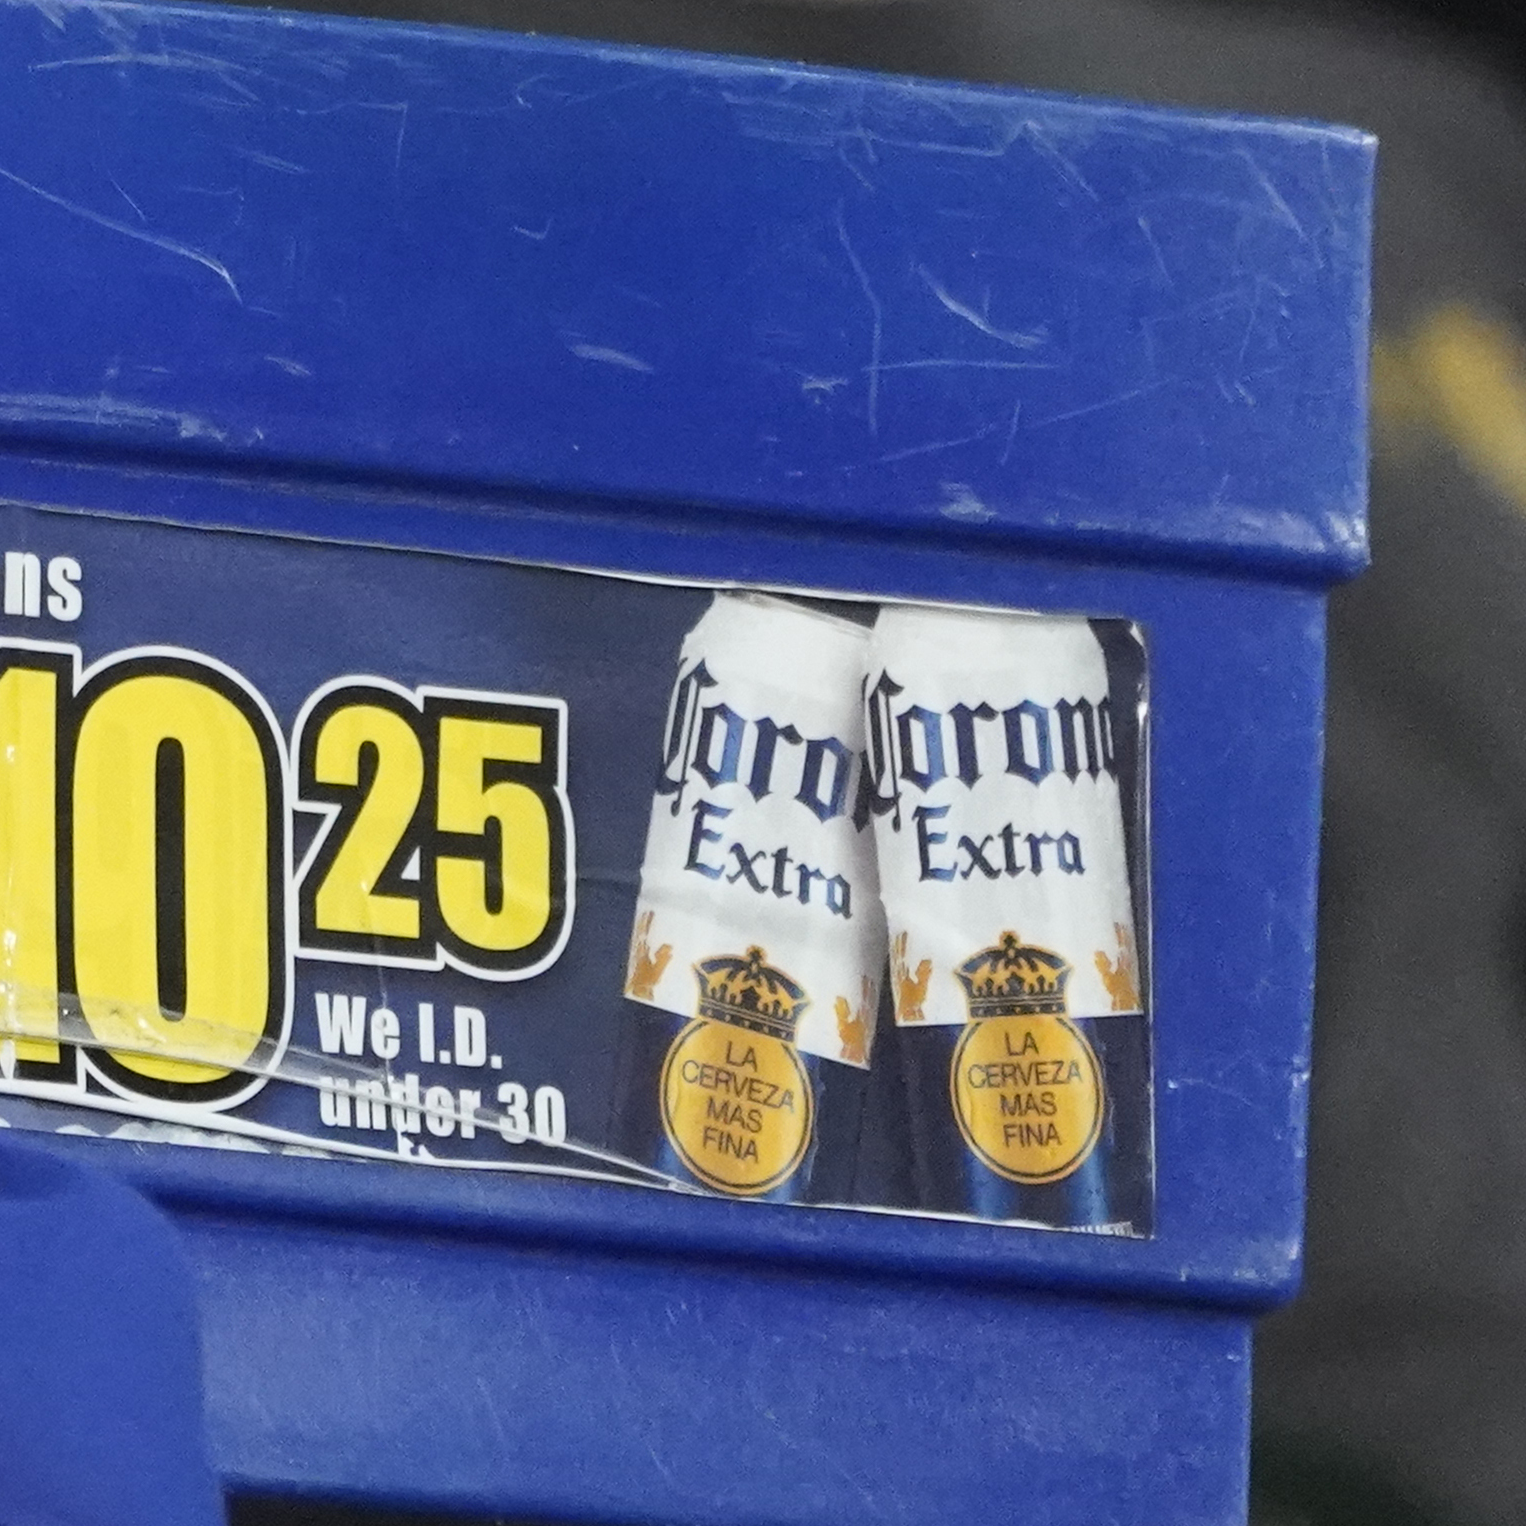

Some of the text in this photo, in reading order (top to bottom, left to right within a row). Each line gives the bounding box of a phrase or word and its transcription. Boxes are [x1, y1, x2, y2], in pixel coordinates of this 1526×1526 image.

[684, 799, 853, 920] Extra
[911, 804, 1086, 883] Extra
[314, 992, 503, 1070] We I.D.
[1004, 1031, 1039, 1057] LA
[725, 1040, 758, 1073] LA
[967, 1060, 1083, 1089] CERVEZA
[682, 1059, 795, 1114] CERVEZA
[1000, 1090, 1058, 1117] MAS
[319, 1073, 567, 1148] under 30
[707, 1095, 763, 1134] MAS
[703, 1126, 759, 1164] FINA
[1003, 1122, 1062, 1149] FINA
